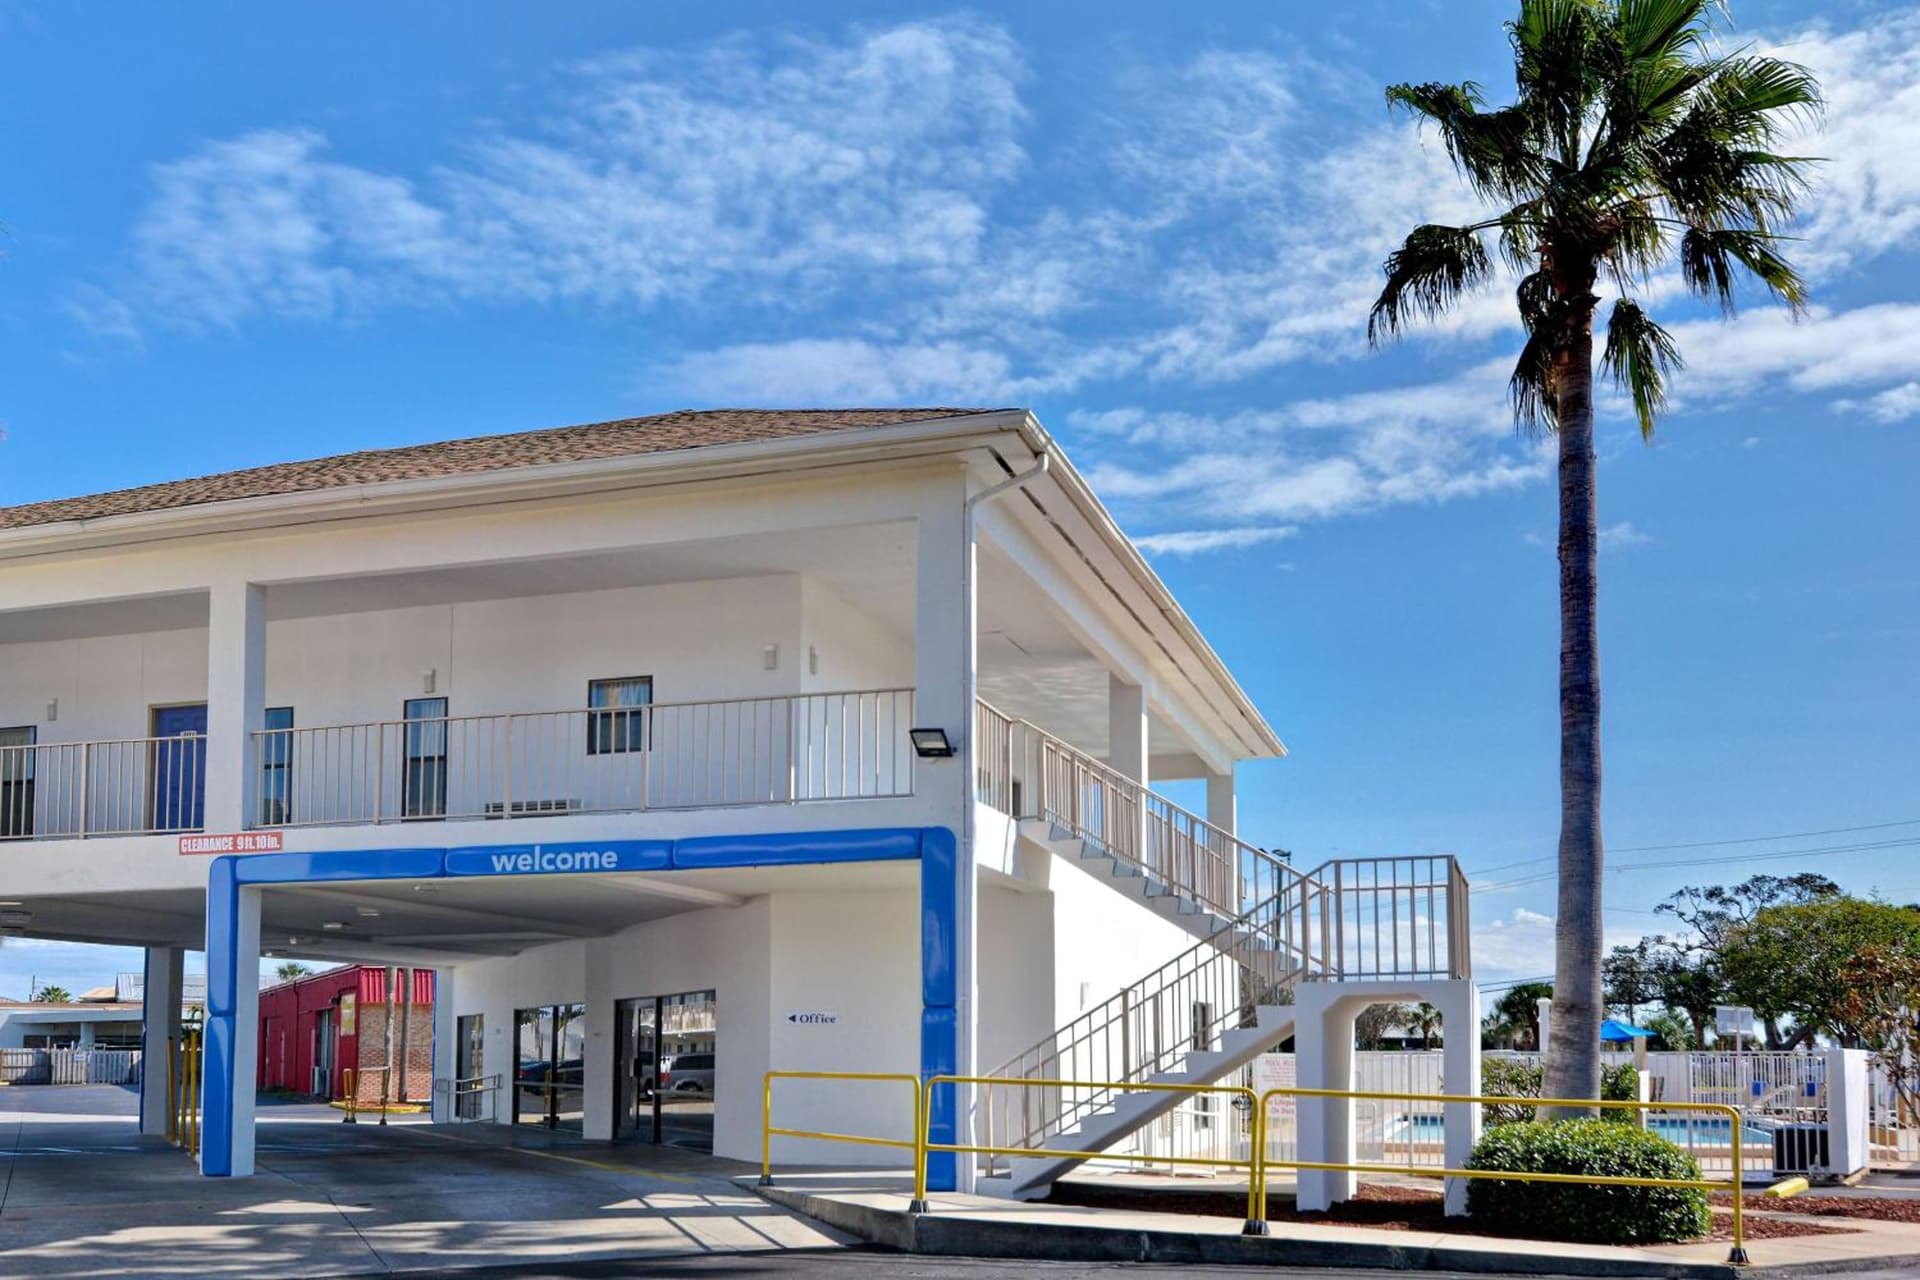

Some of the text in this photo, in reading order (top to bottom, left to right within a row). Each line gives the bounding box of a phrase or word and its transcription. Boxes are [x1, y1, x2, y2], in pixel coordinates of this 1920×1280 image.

[181, 837, 233, 853] CLEARANCE
[491, 845, 618, 872] welcome
[800, 1013, 836, 1024] Office
